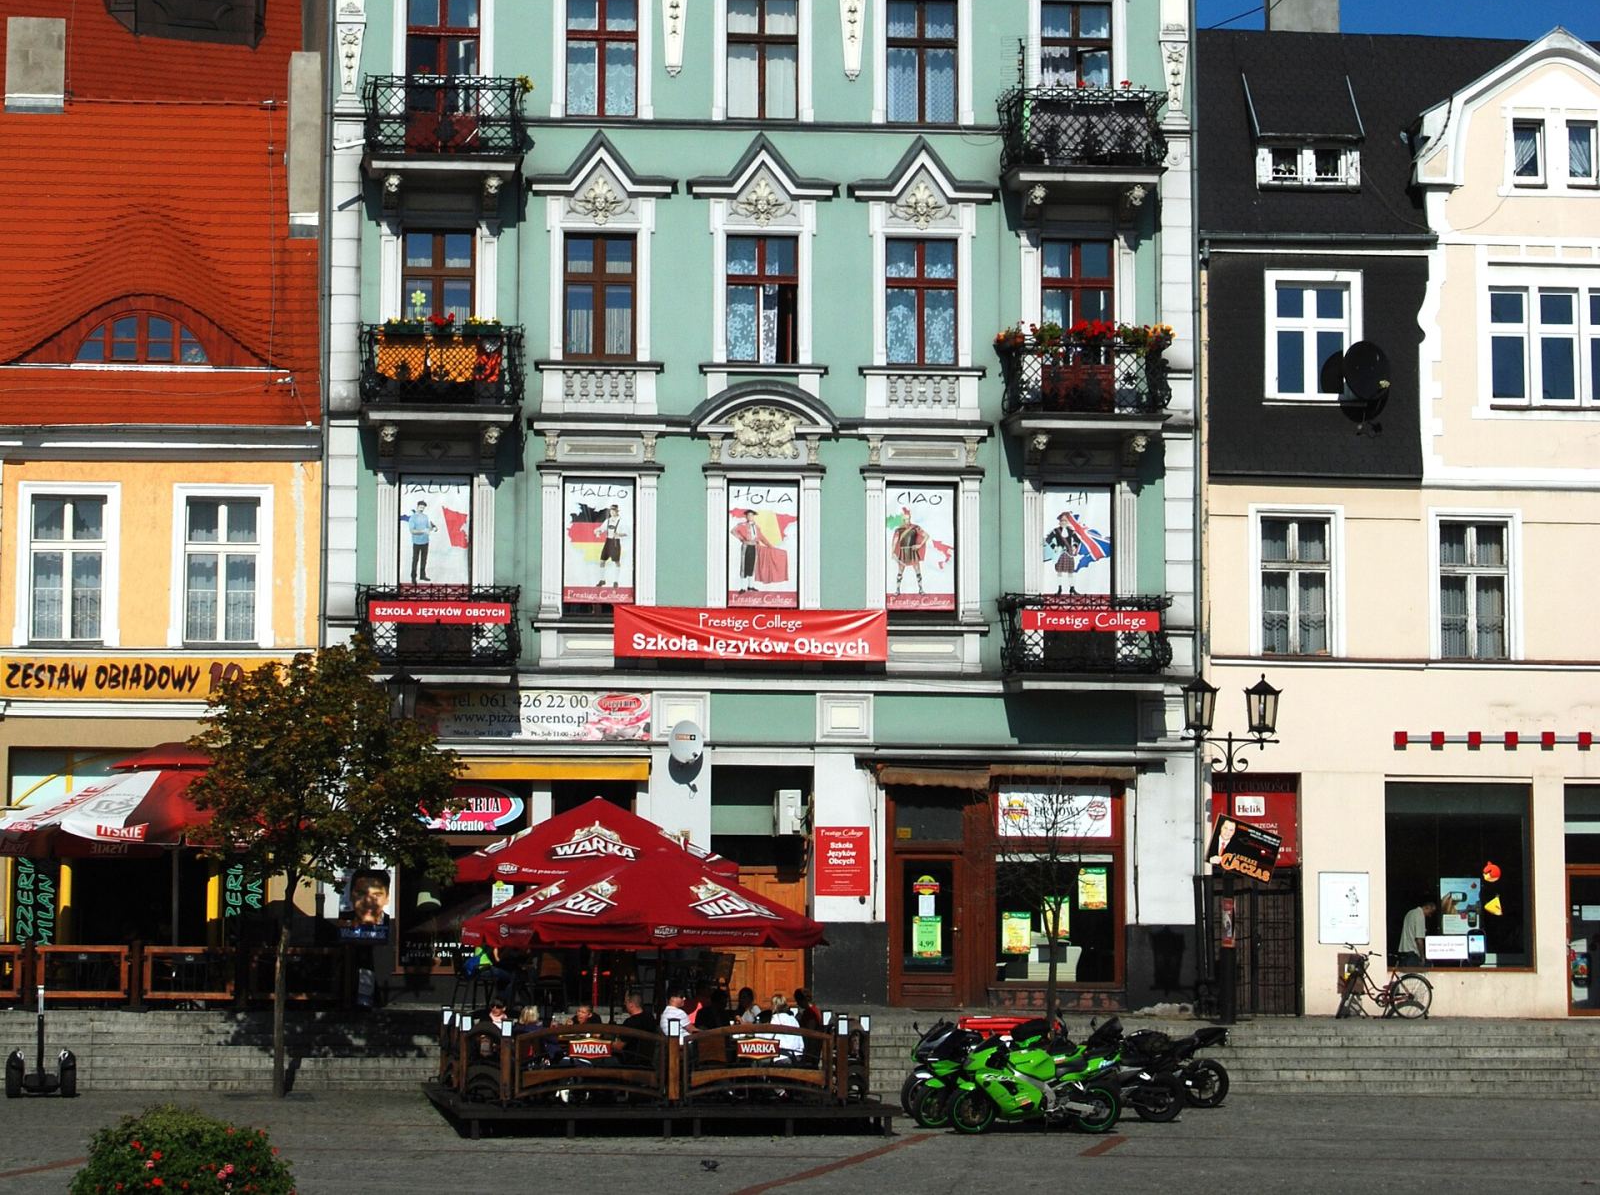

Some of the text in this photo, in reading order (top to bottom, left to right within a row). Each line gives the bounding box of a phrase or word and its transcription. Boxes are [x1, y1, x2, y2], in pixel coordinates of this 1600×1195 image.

[404, 480, 464, 495] SALUT
[571, 485, 629, 499] HALLO
[734, 488, 793, 504] HOLA
[897, 492, 943, 505] CIAO
[1066, 492, 1089, 505] HI
[567, 589, 631, 601] Prestige College
[731, 594, 793, 605] Prestige College
[375, 606, 506, 617] SZKOŁA JĘZYKÓW OBCYCH
[699, 612, 803, 633] Prestige College
[1036, 612, 1147, 628] Prestige College
[632, 633, 870, 658] Szkoła Języków Obcych
[5, 662, 89, 692] ZESTAW
[95, 662, 200, 693] OBIADOWY
[480, 694, 507, 708] 061
[512, 694, 542, 709] 426
[546, 694, 566, 709] 22
[569, 694, 589, 709] 00
[453, 711, 589, 727] www.pizza-sorento.pl
[1213, 779, 1291, 792] NIEUCHOMOŚCI
[1237, 805, 1262, 813] Helik
[99, 825, 143, 839] TYSKIE
[445, 819, 485, 831] Sorento
[555, 838, 635, 858] WARKA
[572, 1044, 608, 1055] WARKA
[740, 1044, 776, 1054] WARKA
